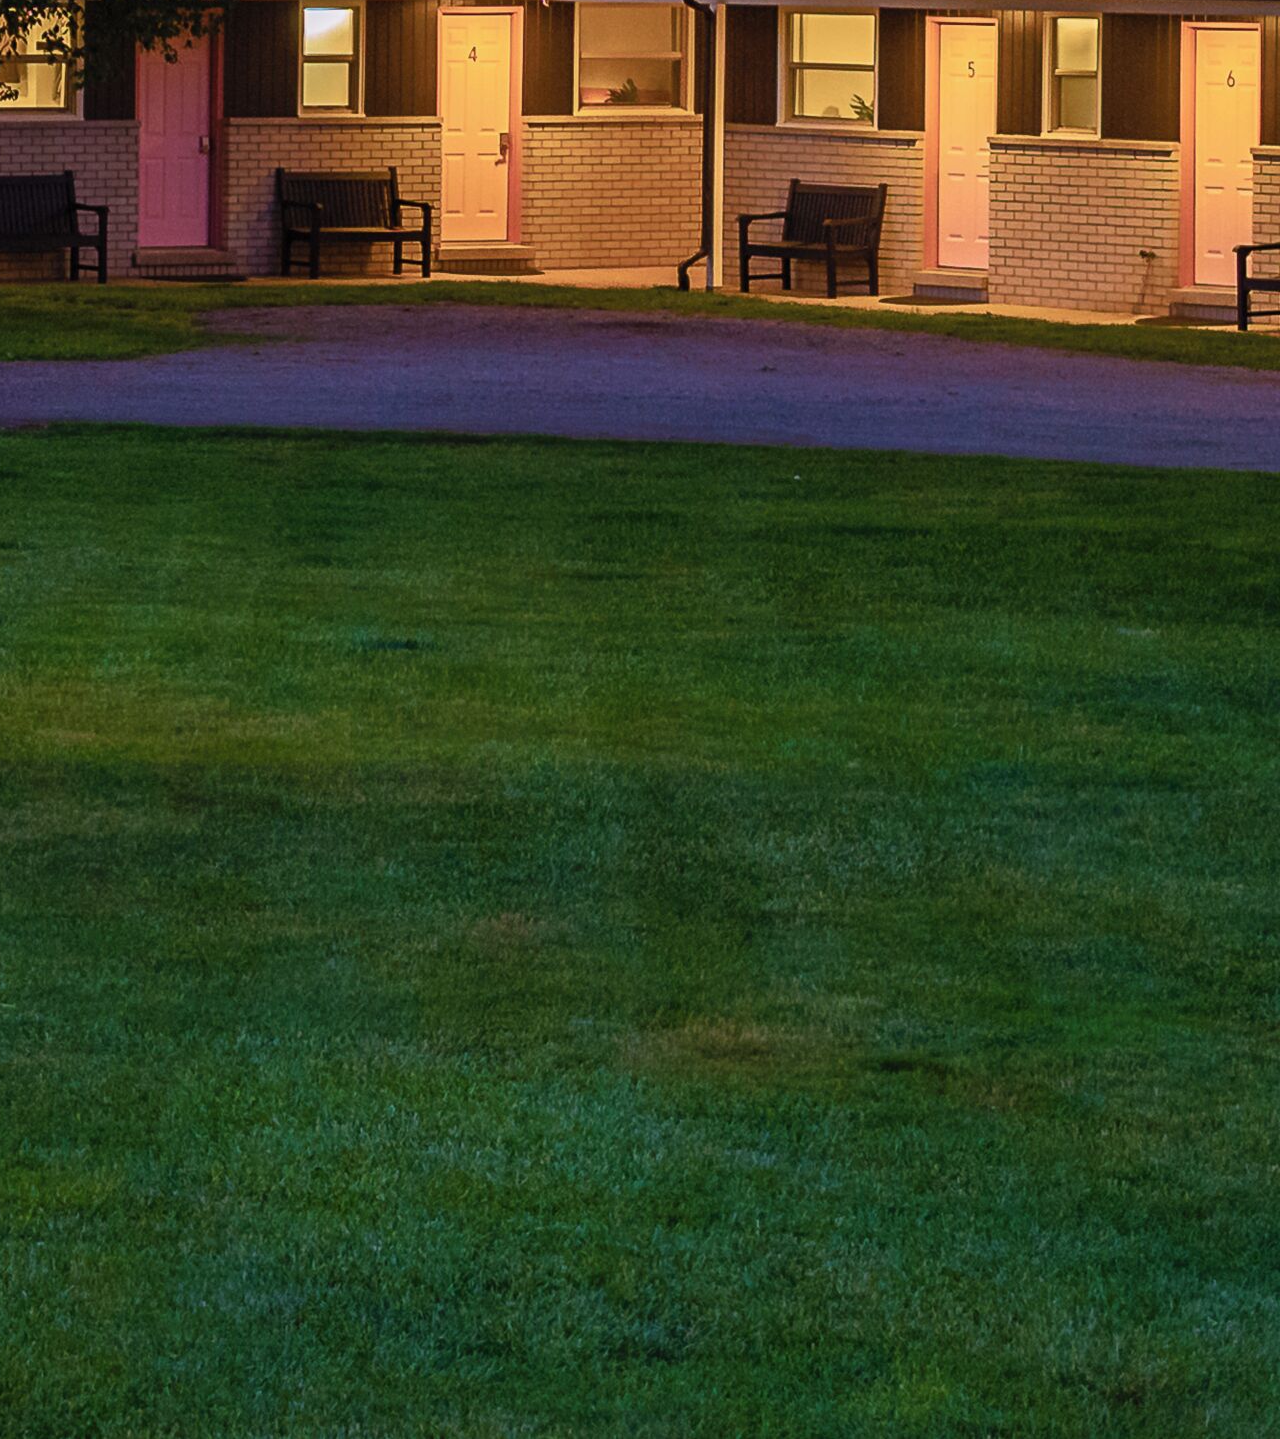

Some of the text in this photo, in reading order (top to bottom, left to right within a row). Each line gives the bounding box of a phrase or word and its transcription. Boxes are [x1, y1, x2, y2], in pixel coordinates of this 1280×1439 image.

[467, 46, 478, 63] 4
[967, 60, 976, 79] 5
[1226, 69, 1236, 88] 6
